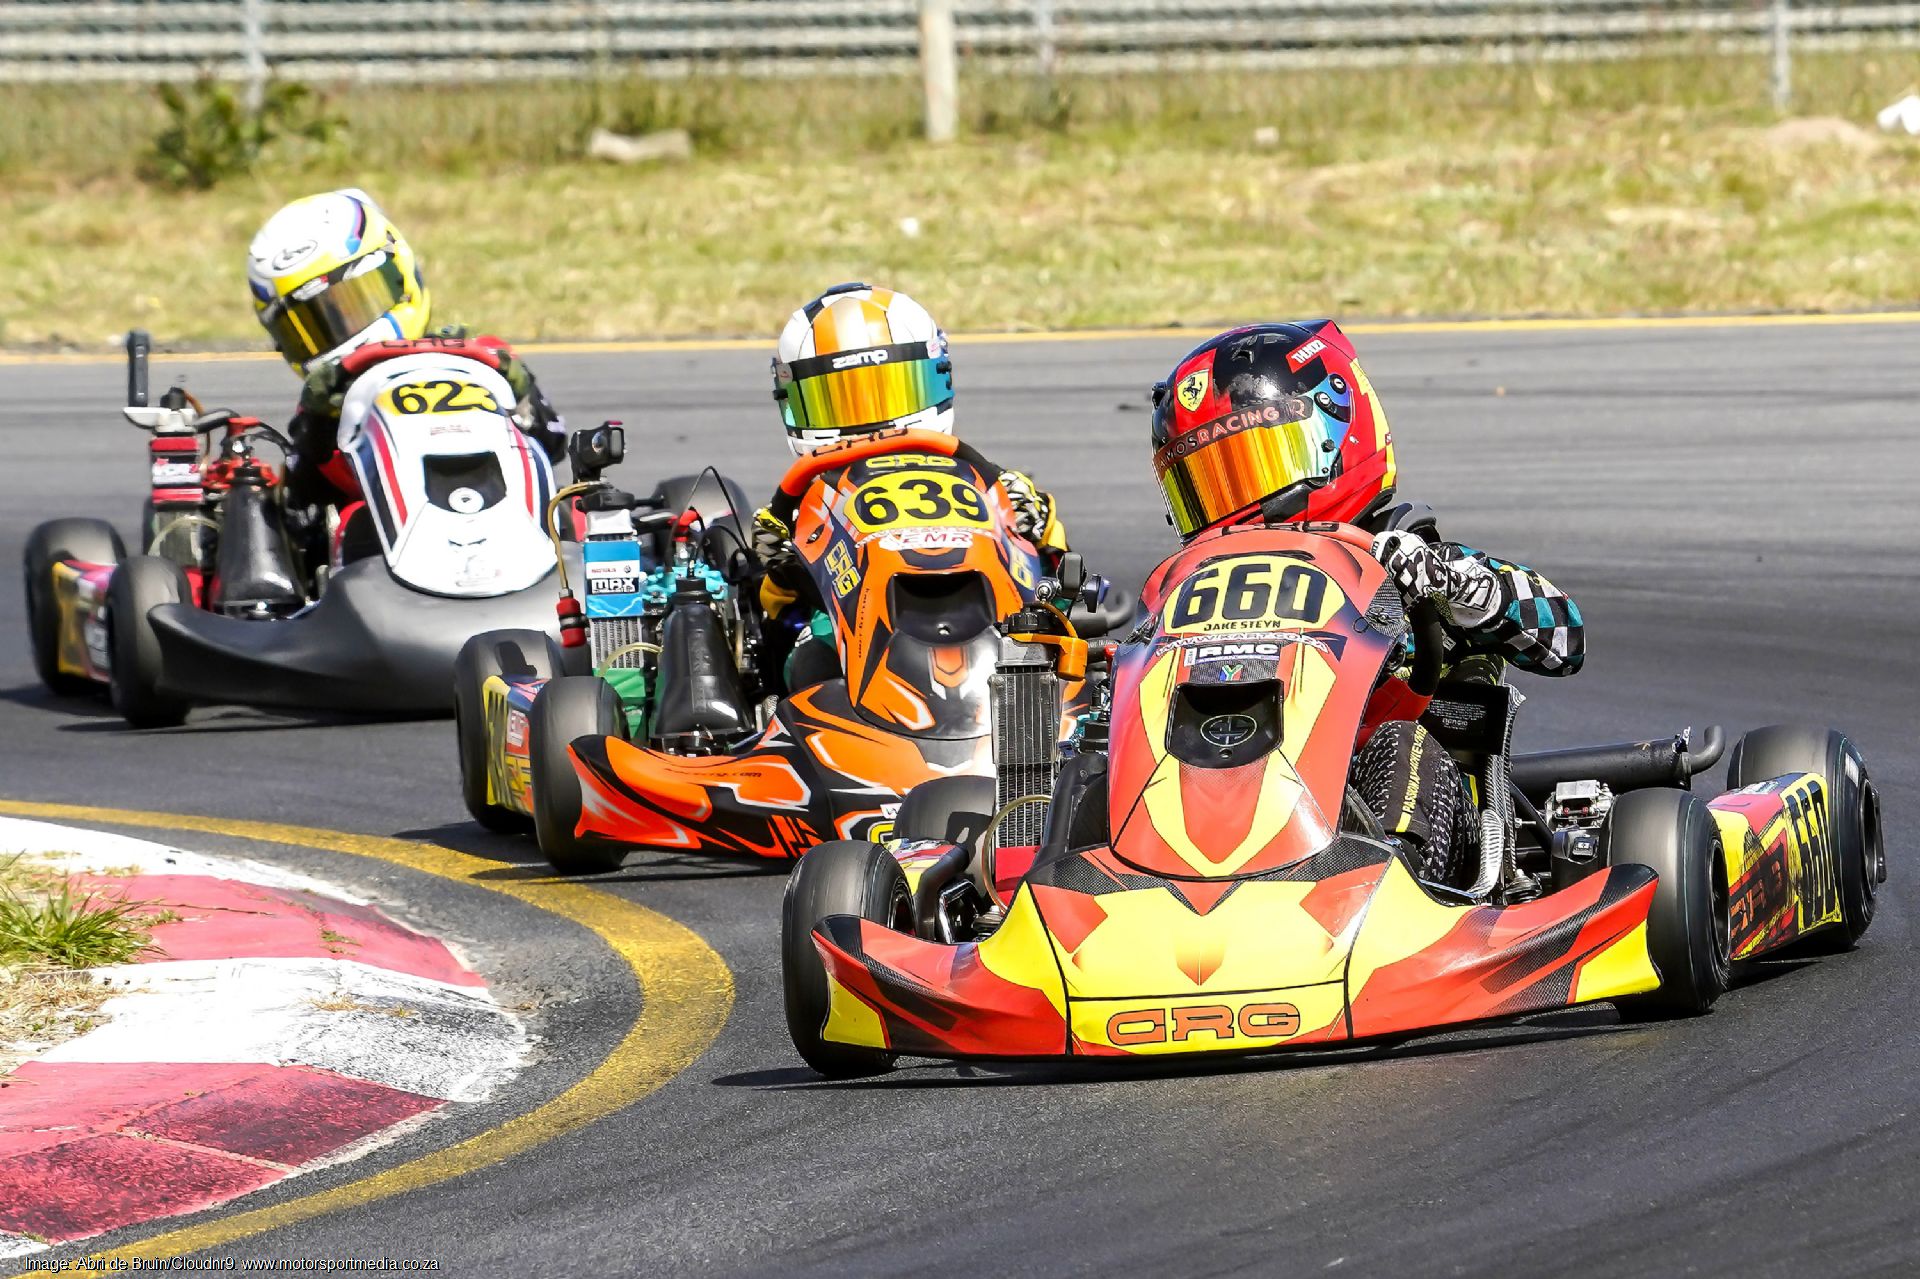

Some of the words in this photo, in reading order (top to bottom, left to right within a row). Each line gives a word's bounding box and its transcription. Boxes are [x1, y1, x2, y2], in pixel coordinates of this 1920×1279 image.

[831, 349, 889, 369] zamp
[391, 380, 506, 416] 623
[866, 454, 958, 468] CRG
[854, 478, 990, 526] 639
[1170, 563, 1328, 630] 660
[1204, 622, 1237, 631] JAKE
[1240, 620, 1281, 629] STEYN
[1199, 643, 1280, 658] RMC
[1106, 1002, 1301, 1046] CRG
